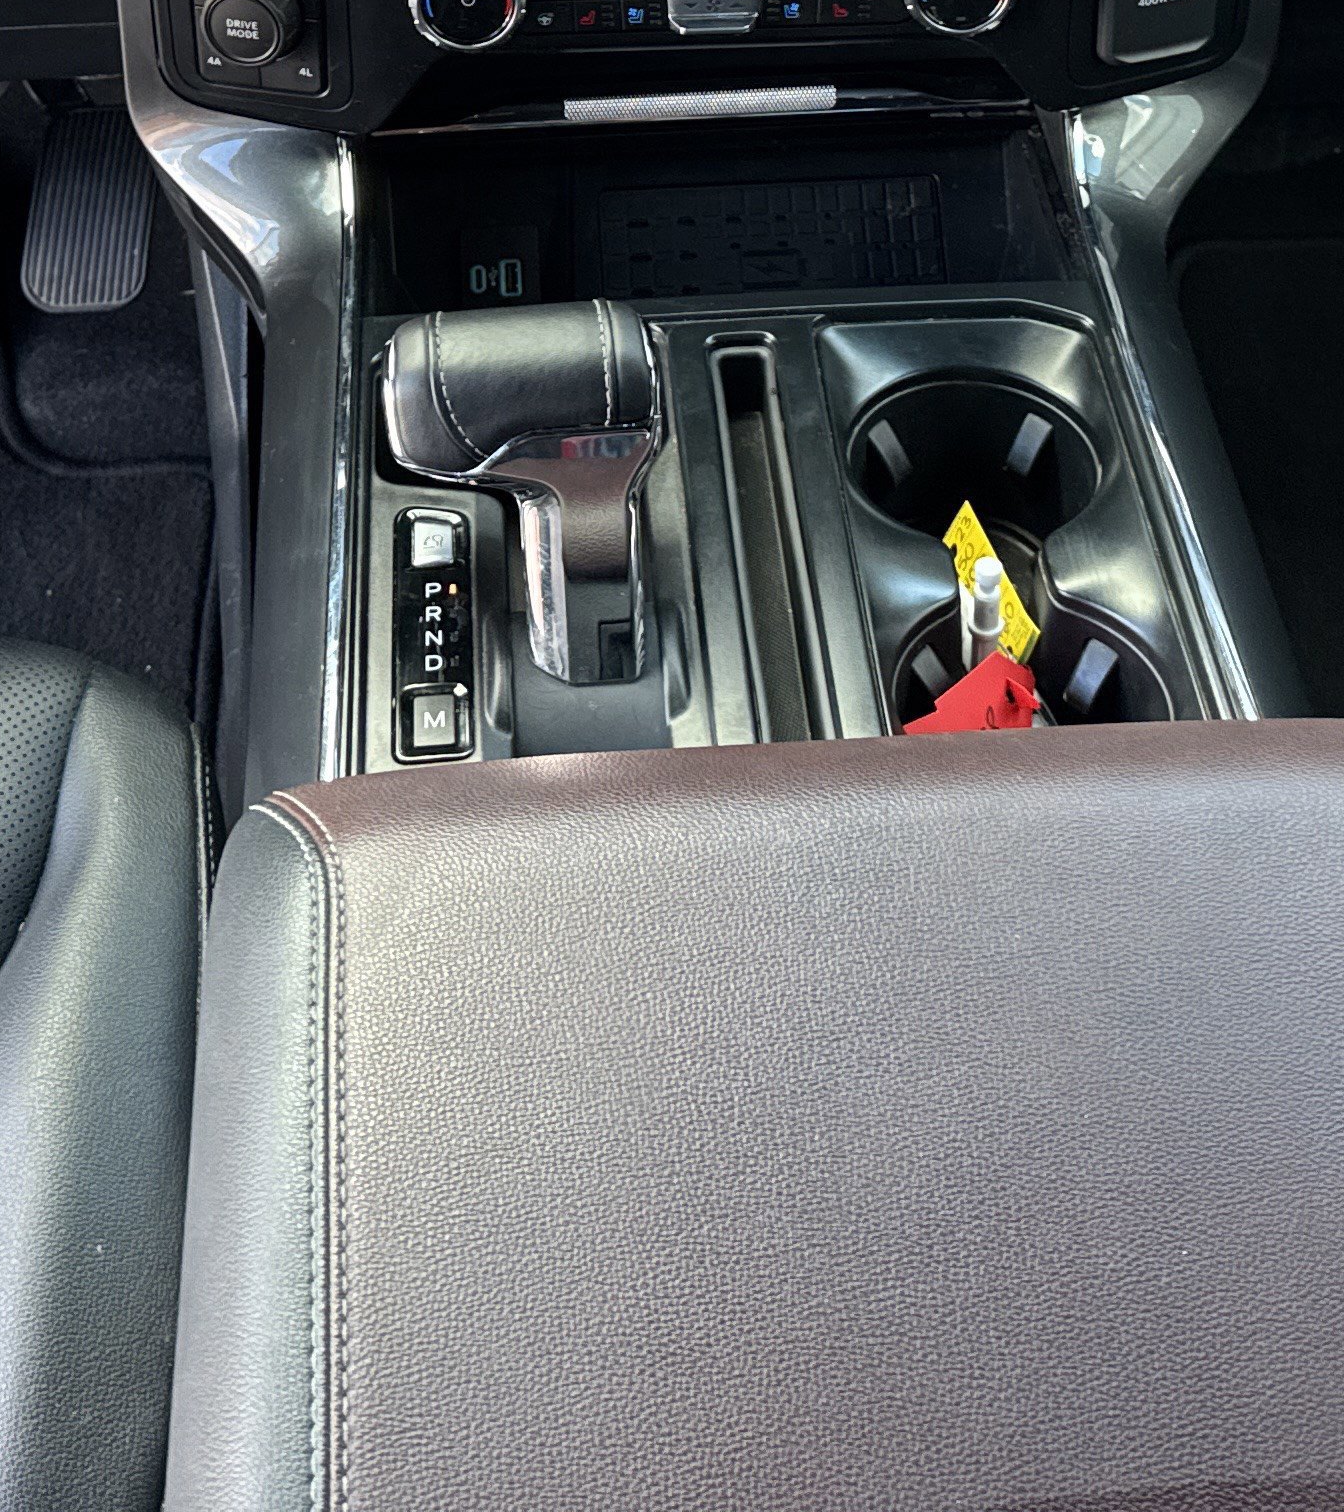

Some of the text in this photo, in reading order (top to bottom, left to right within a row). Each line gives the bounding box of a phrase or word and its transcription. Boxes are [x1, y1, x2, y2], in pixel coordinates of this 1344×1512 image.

[225, 18, 259, 30] DRIVE
[226, 28, 260, 40] MODE
[206, 56, 222, 67] 4A
[298, 67, 313, 78] 4L
[425, 582, 442, 598] P
[425, 605, 442, 622] R
[425, 630, 443, 647] N
[425, 655, 444, 672] D
[423, 711, 446, 729] M
